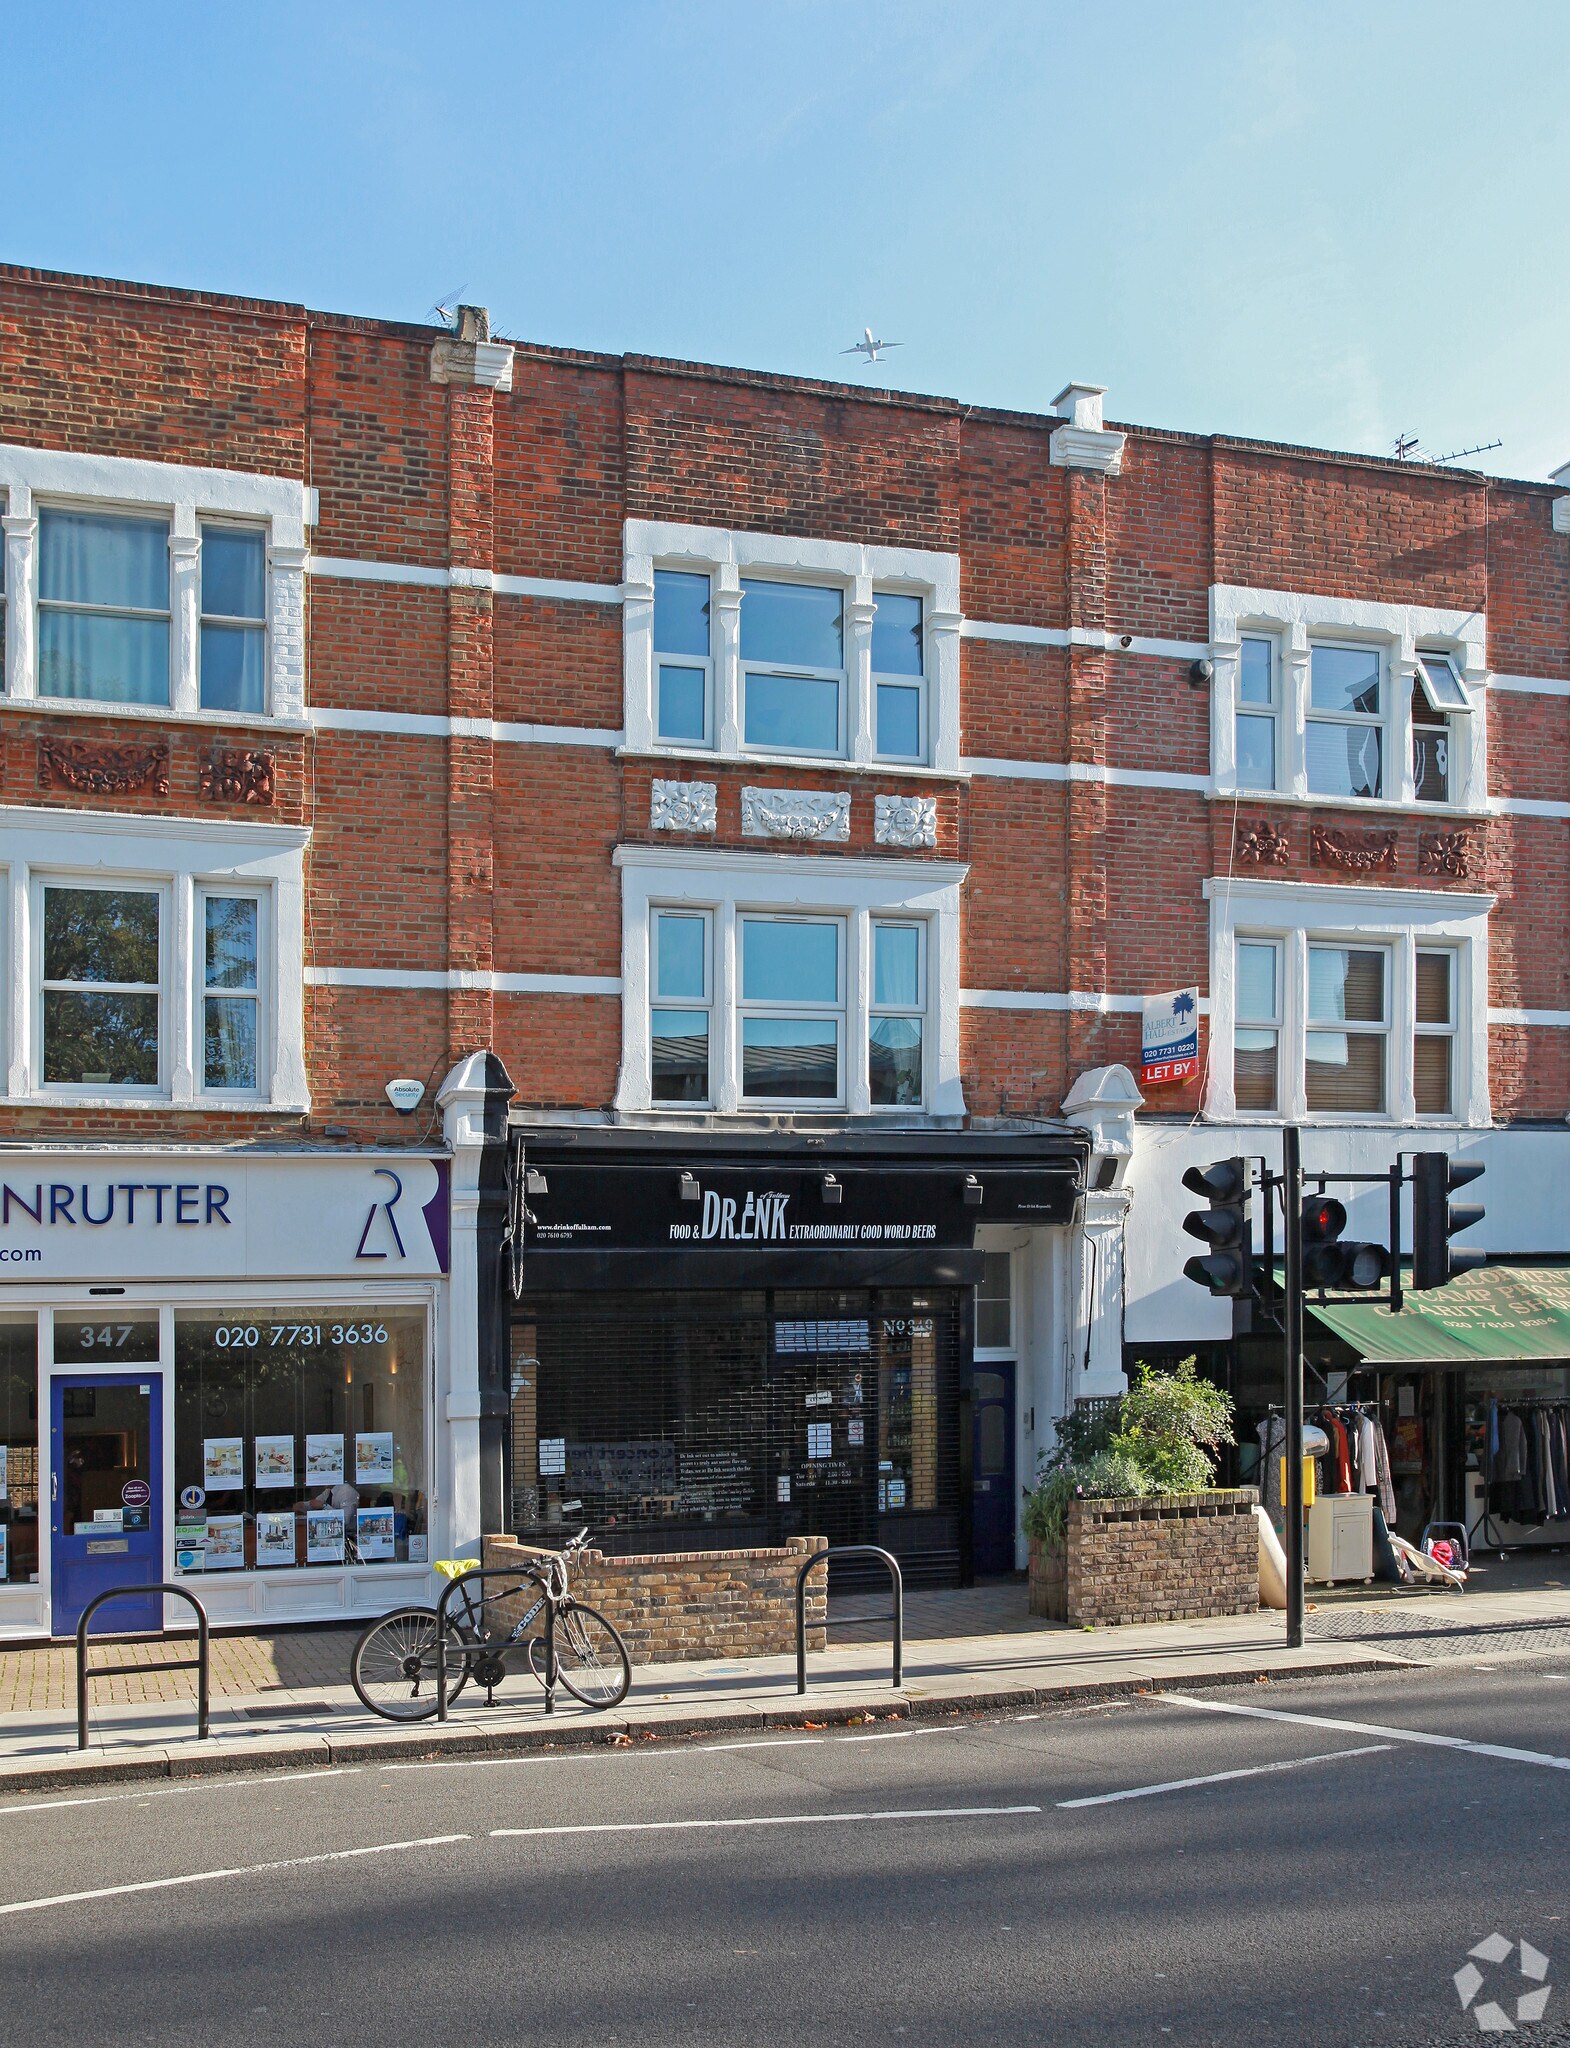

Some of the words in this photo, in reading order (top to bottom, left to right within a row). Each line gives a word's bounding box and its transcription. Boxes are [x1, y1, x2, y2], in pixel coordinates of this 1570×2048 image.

[1145, 1017, 1177, 1031] ALBERT
[1167, 1026, 1194, 1036] ESTATES
[1144, 1050, 1157, 1058] 020
[1159, 1046, 1175, 1055] 7731
[1177, 1043, 1194, 1052] 0220
[1146, 1065, 1170, 1080] LET
[1173, 1061, 1191, 1075] BY
[3, 1184, 232, 1225] NRUTTER
[537, 1223, 612, 1231] www.drinkoffulham.com
[669, 1224, 691, 1240] FOOD
[692, 1225, 700, 1239] &
[789, 1224, 860, 1239] EXTRAORDINARILY
[860, 1224, 882, 1239] GOOD
[883, 1224, 911, 1239] WORLD
[911, 1224, 936, 1239] BEERS
[1417, 1288, 1492, 1302] CAMP
[1442, 1320, 1472, 1329] 020
[80, 1325, 134, 1348] 347
[215, 1326, 260, 1348] 020
[270, 1325, 321, 1346] 7731
[331, 1323, 389, 1345] 3636
